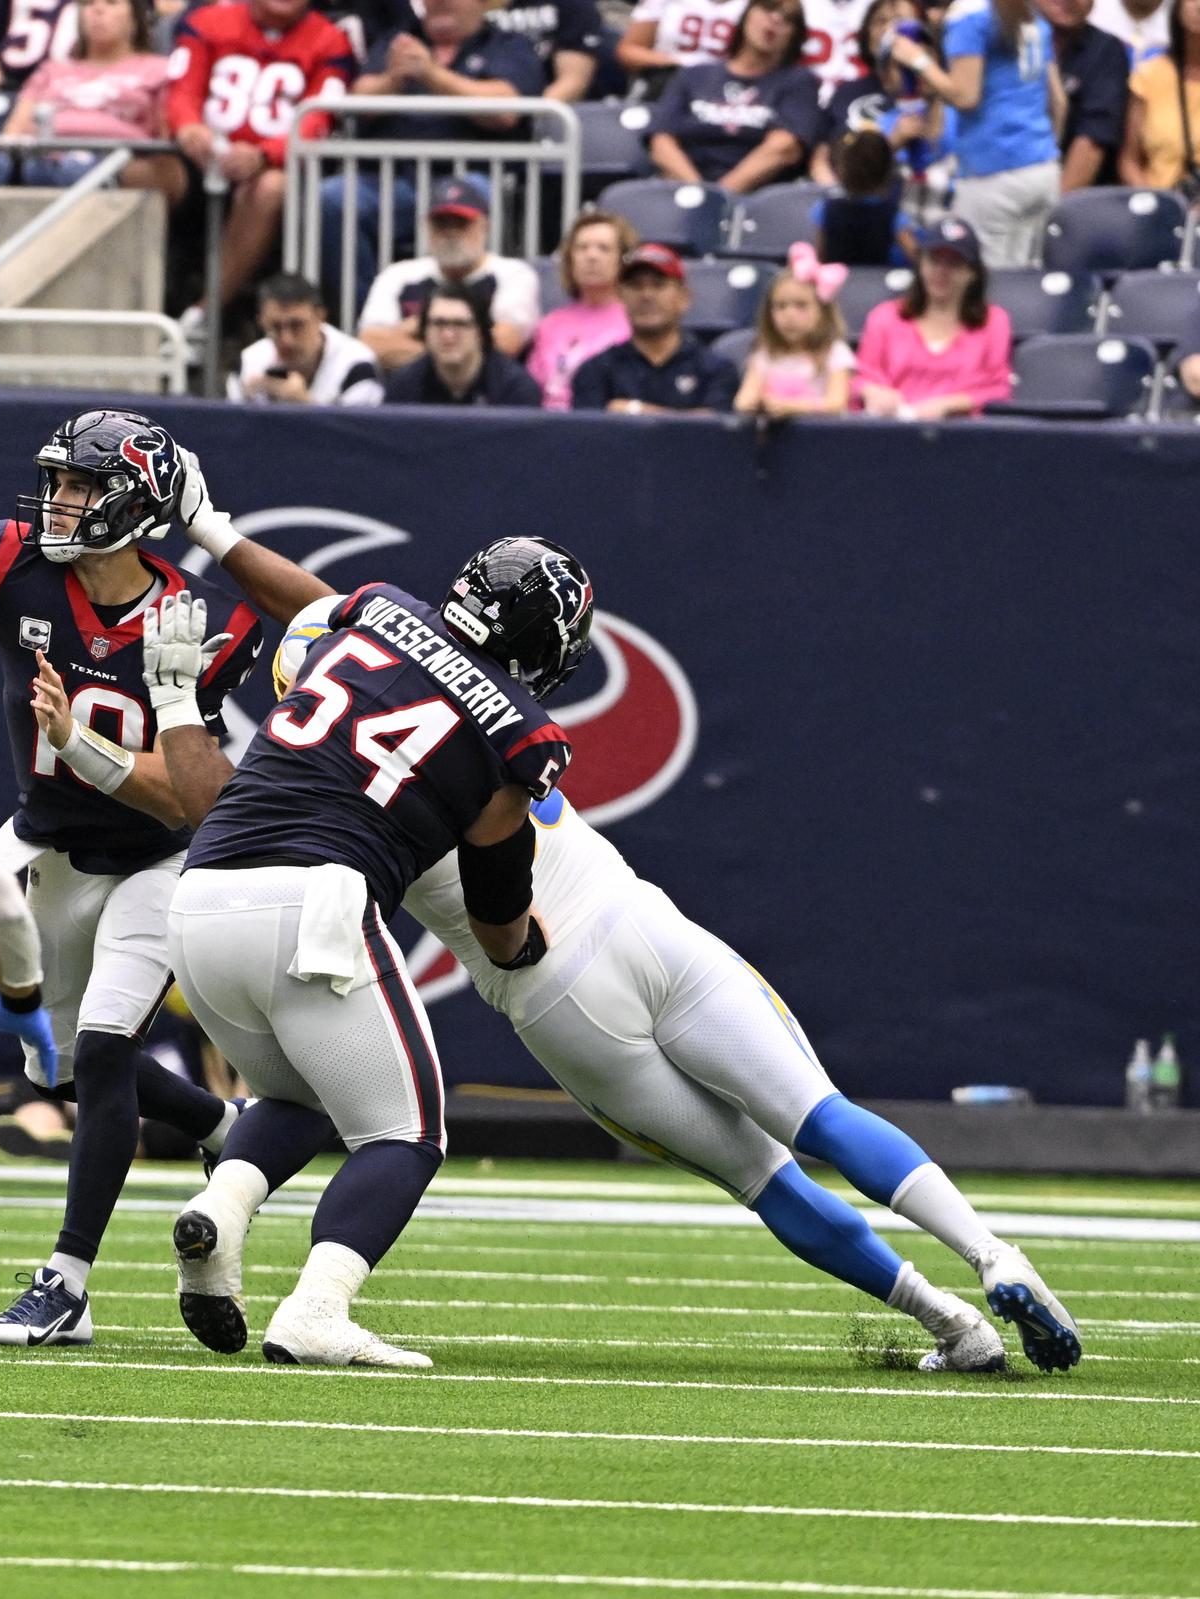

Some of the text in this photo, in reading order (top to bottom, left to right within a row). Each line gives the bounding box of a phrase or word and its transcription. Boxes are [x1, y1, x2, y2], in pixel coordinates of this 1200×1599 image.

[22, 620, 49, 644] C
[447, 608, 482, 637] TEXANS
[69, 662, 118, 682] TEXANS
[267, 631, 464, 809] 54
